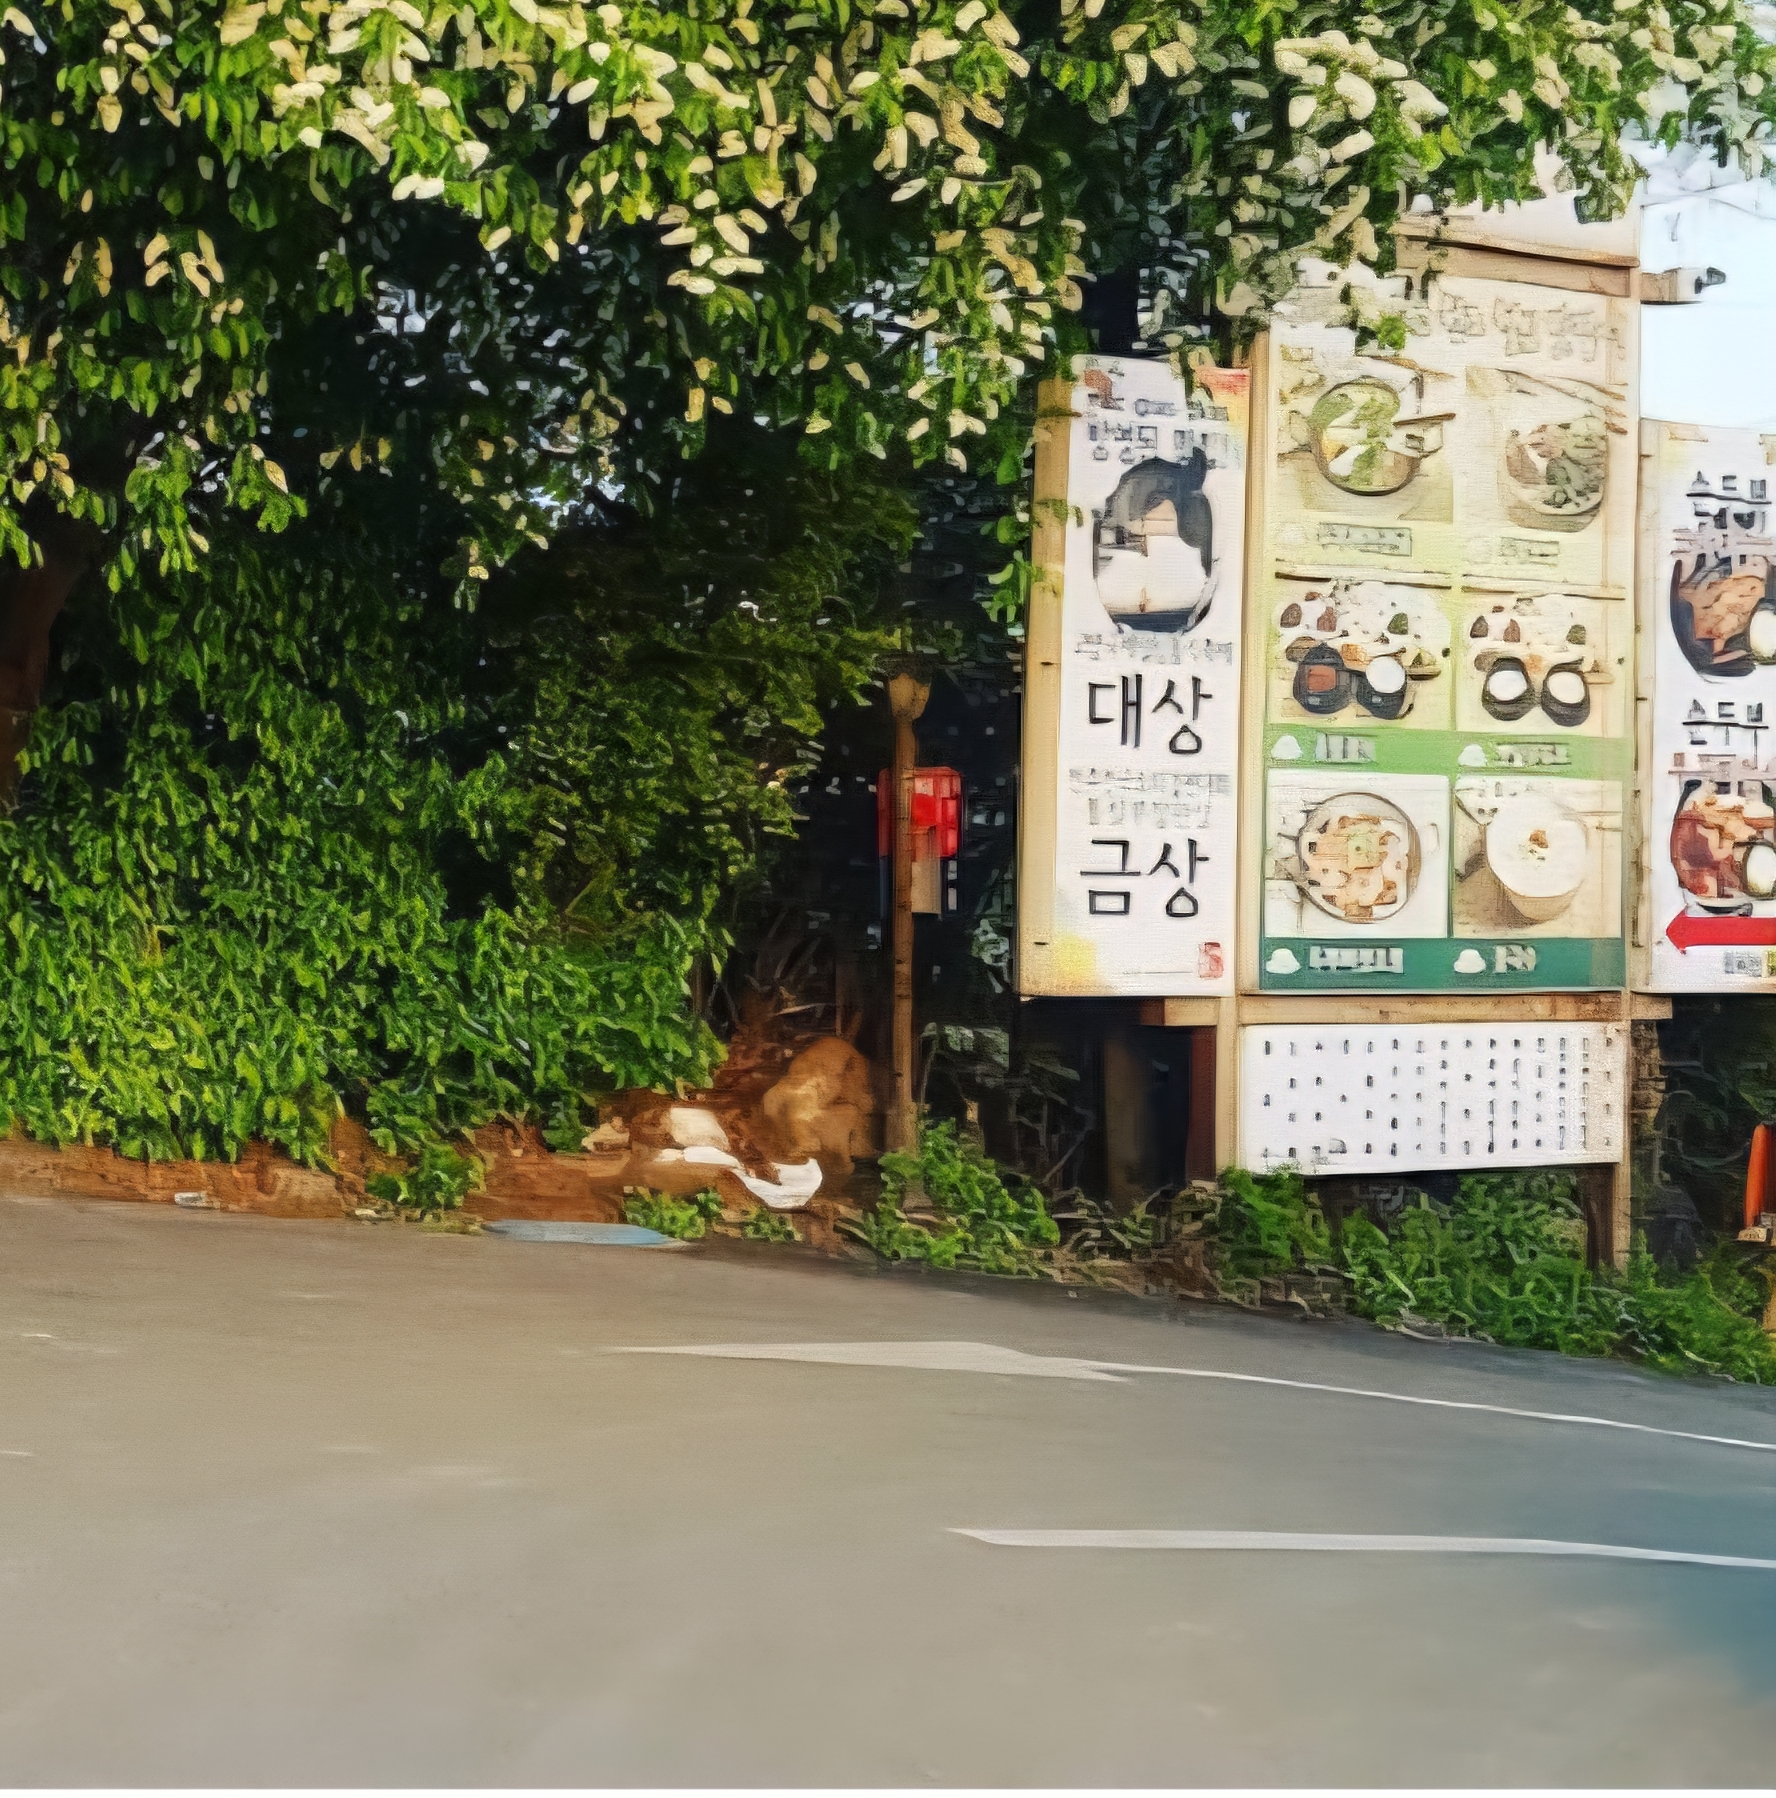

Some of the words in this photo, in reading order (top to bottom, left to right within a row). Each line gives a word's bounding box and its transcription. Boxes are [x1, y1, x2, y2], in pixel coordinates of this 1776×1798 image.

[1088, 673, 1213, 755] 대상
[1682, 699, 1769, 752] 순두부
[1079, 837, 1210, 918] 금상
